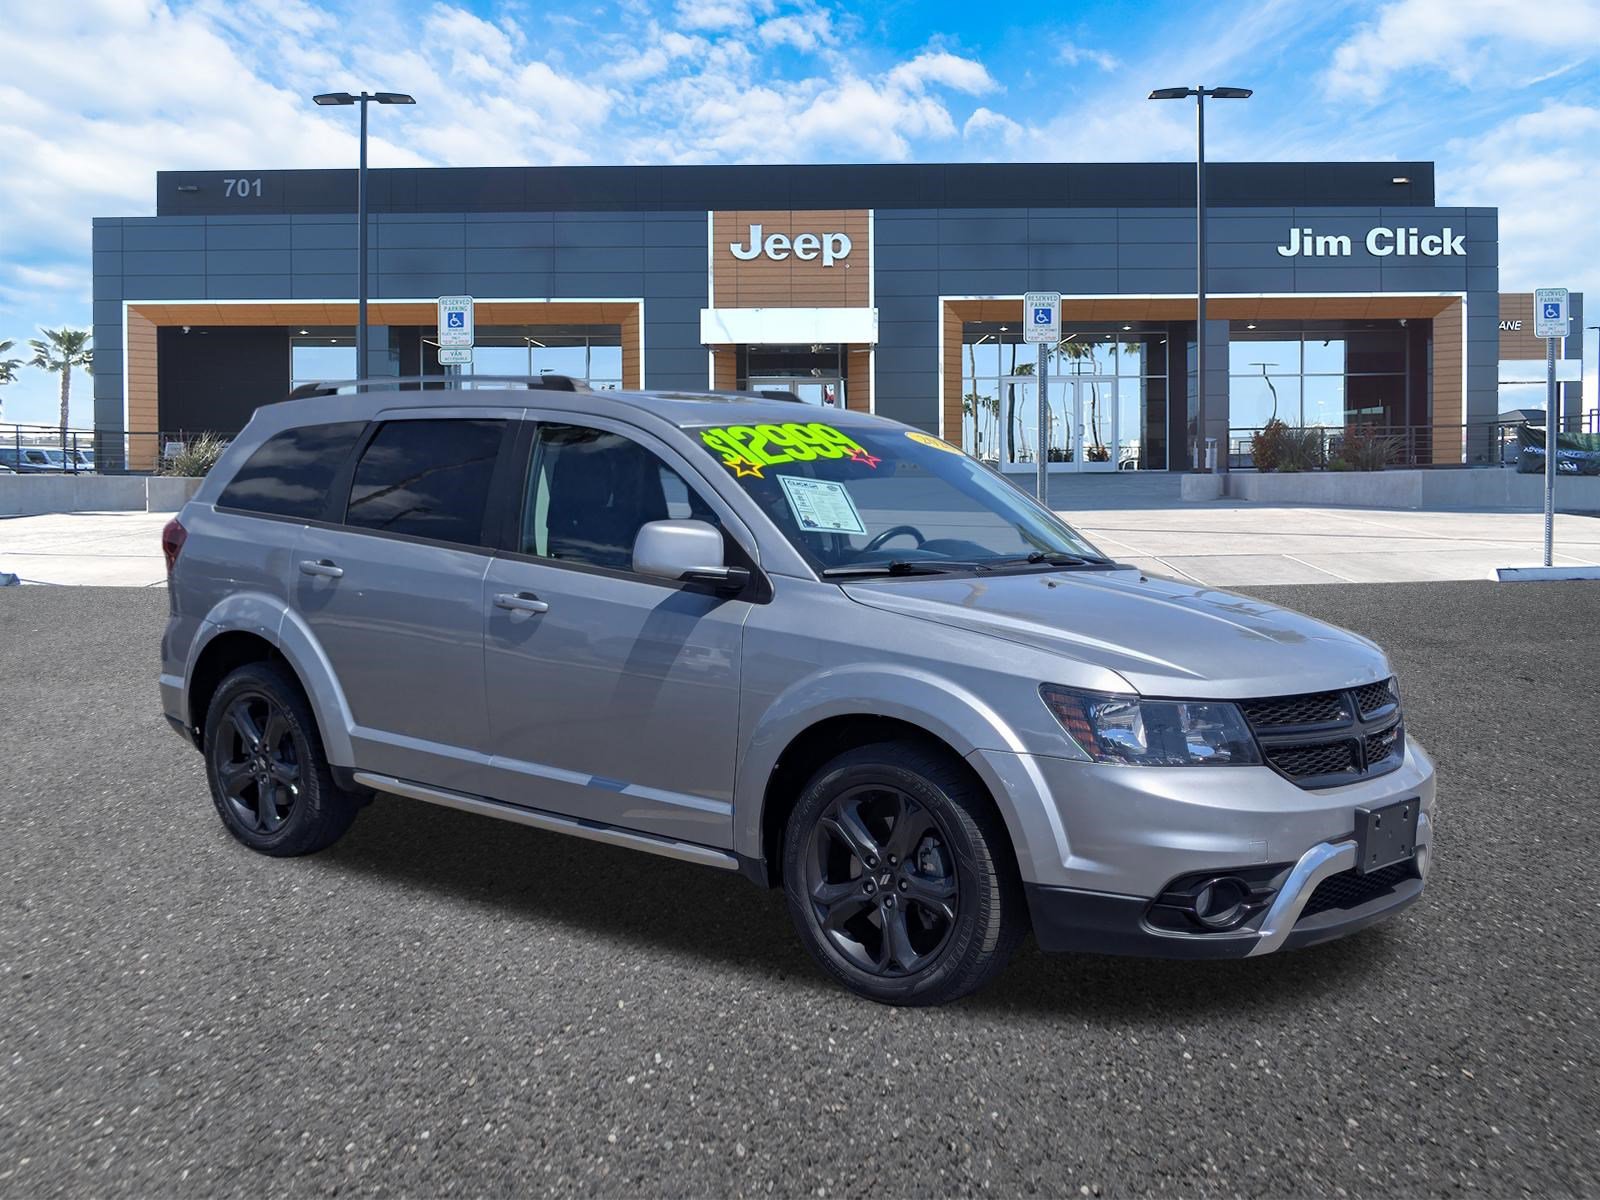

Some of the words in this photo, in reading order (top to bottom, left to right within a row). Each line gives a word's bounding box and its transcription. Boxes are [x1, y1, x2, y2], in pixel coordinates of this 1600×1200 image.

[223, 178, 262, 197] 701
[730, 224, 852, 268] Jeep
[1277, 227, 1352, 257] Jim
[1365, 226, 1467, 257] Click
